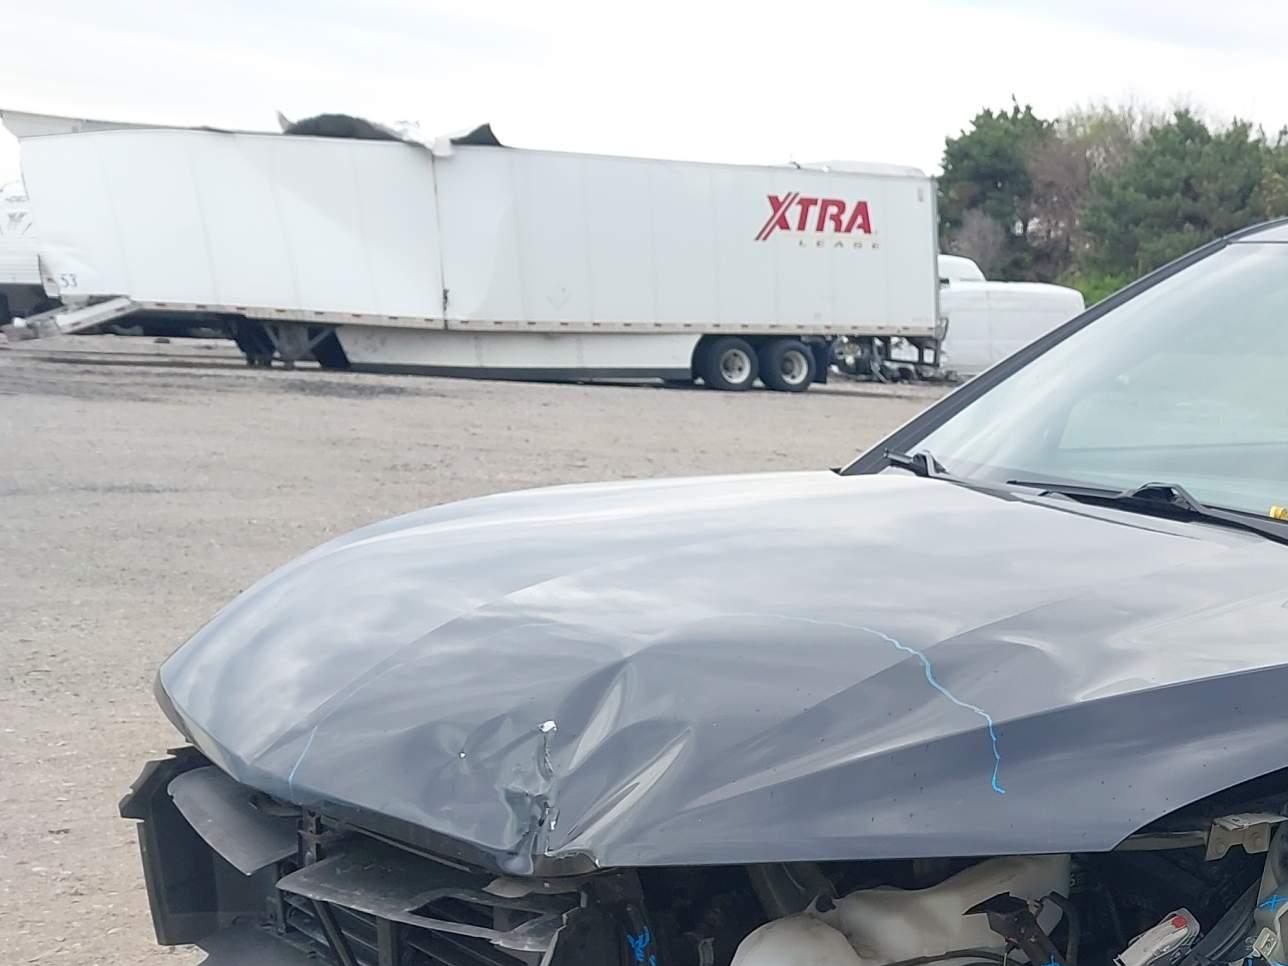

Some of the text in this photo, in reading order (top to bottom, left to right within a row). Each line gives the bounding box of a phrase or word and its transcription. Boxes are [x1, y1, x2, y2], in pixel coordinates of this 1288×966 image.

[754, 191, 873, 242] XTRA
[798, 240, 881, 249] LEASE
[59, 273, 79, 289] 53
